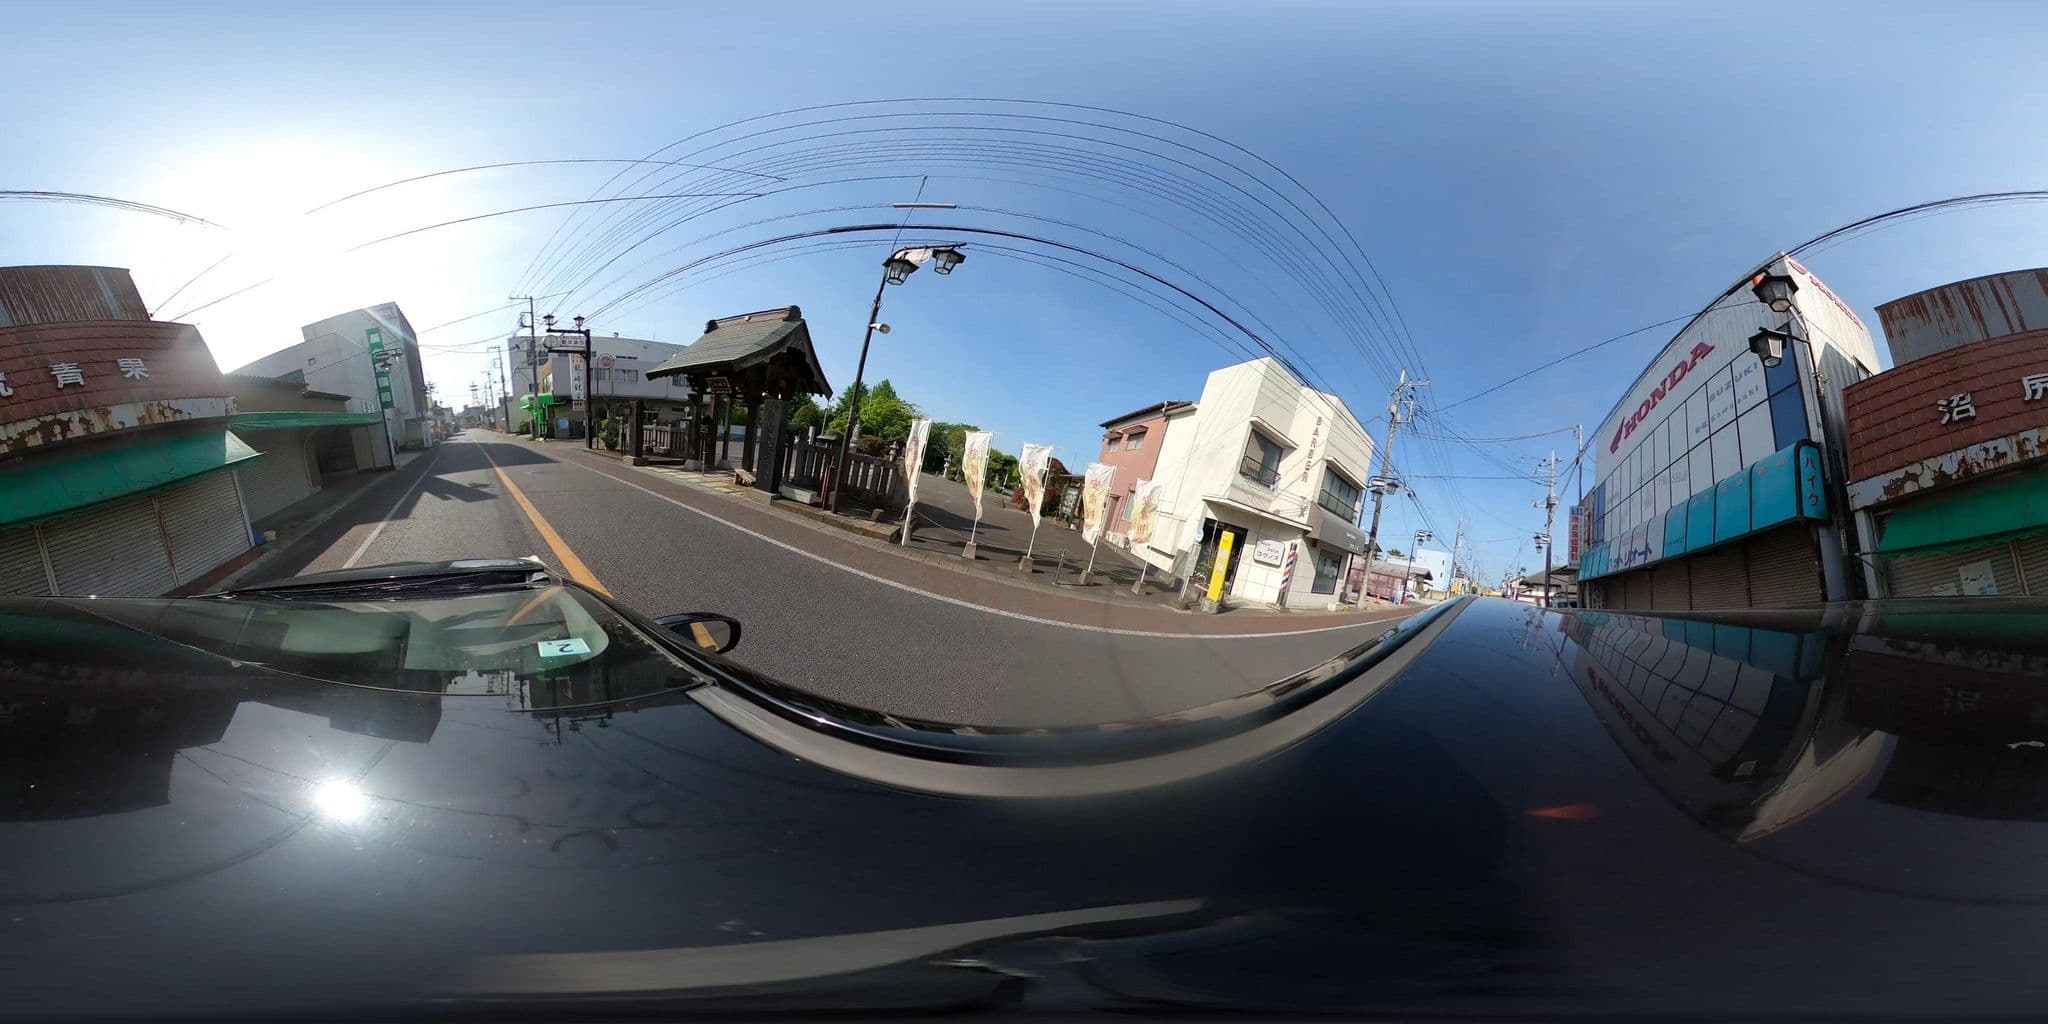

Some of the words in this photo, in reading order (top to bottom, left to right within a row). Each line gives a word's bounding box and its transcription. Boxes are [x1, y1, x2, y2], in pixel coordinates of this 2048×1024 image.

[1624, 342, 1715, 439] HONDA
[1709, 361, 1758, 400] SUZUKI
[1301, 416, 1322, 483] BARBER
[1804, 455, 1821, 508] バイク
